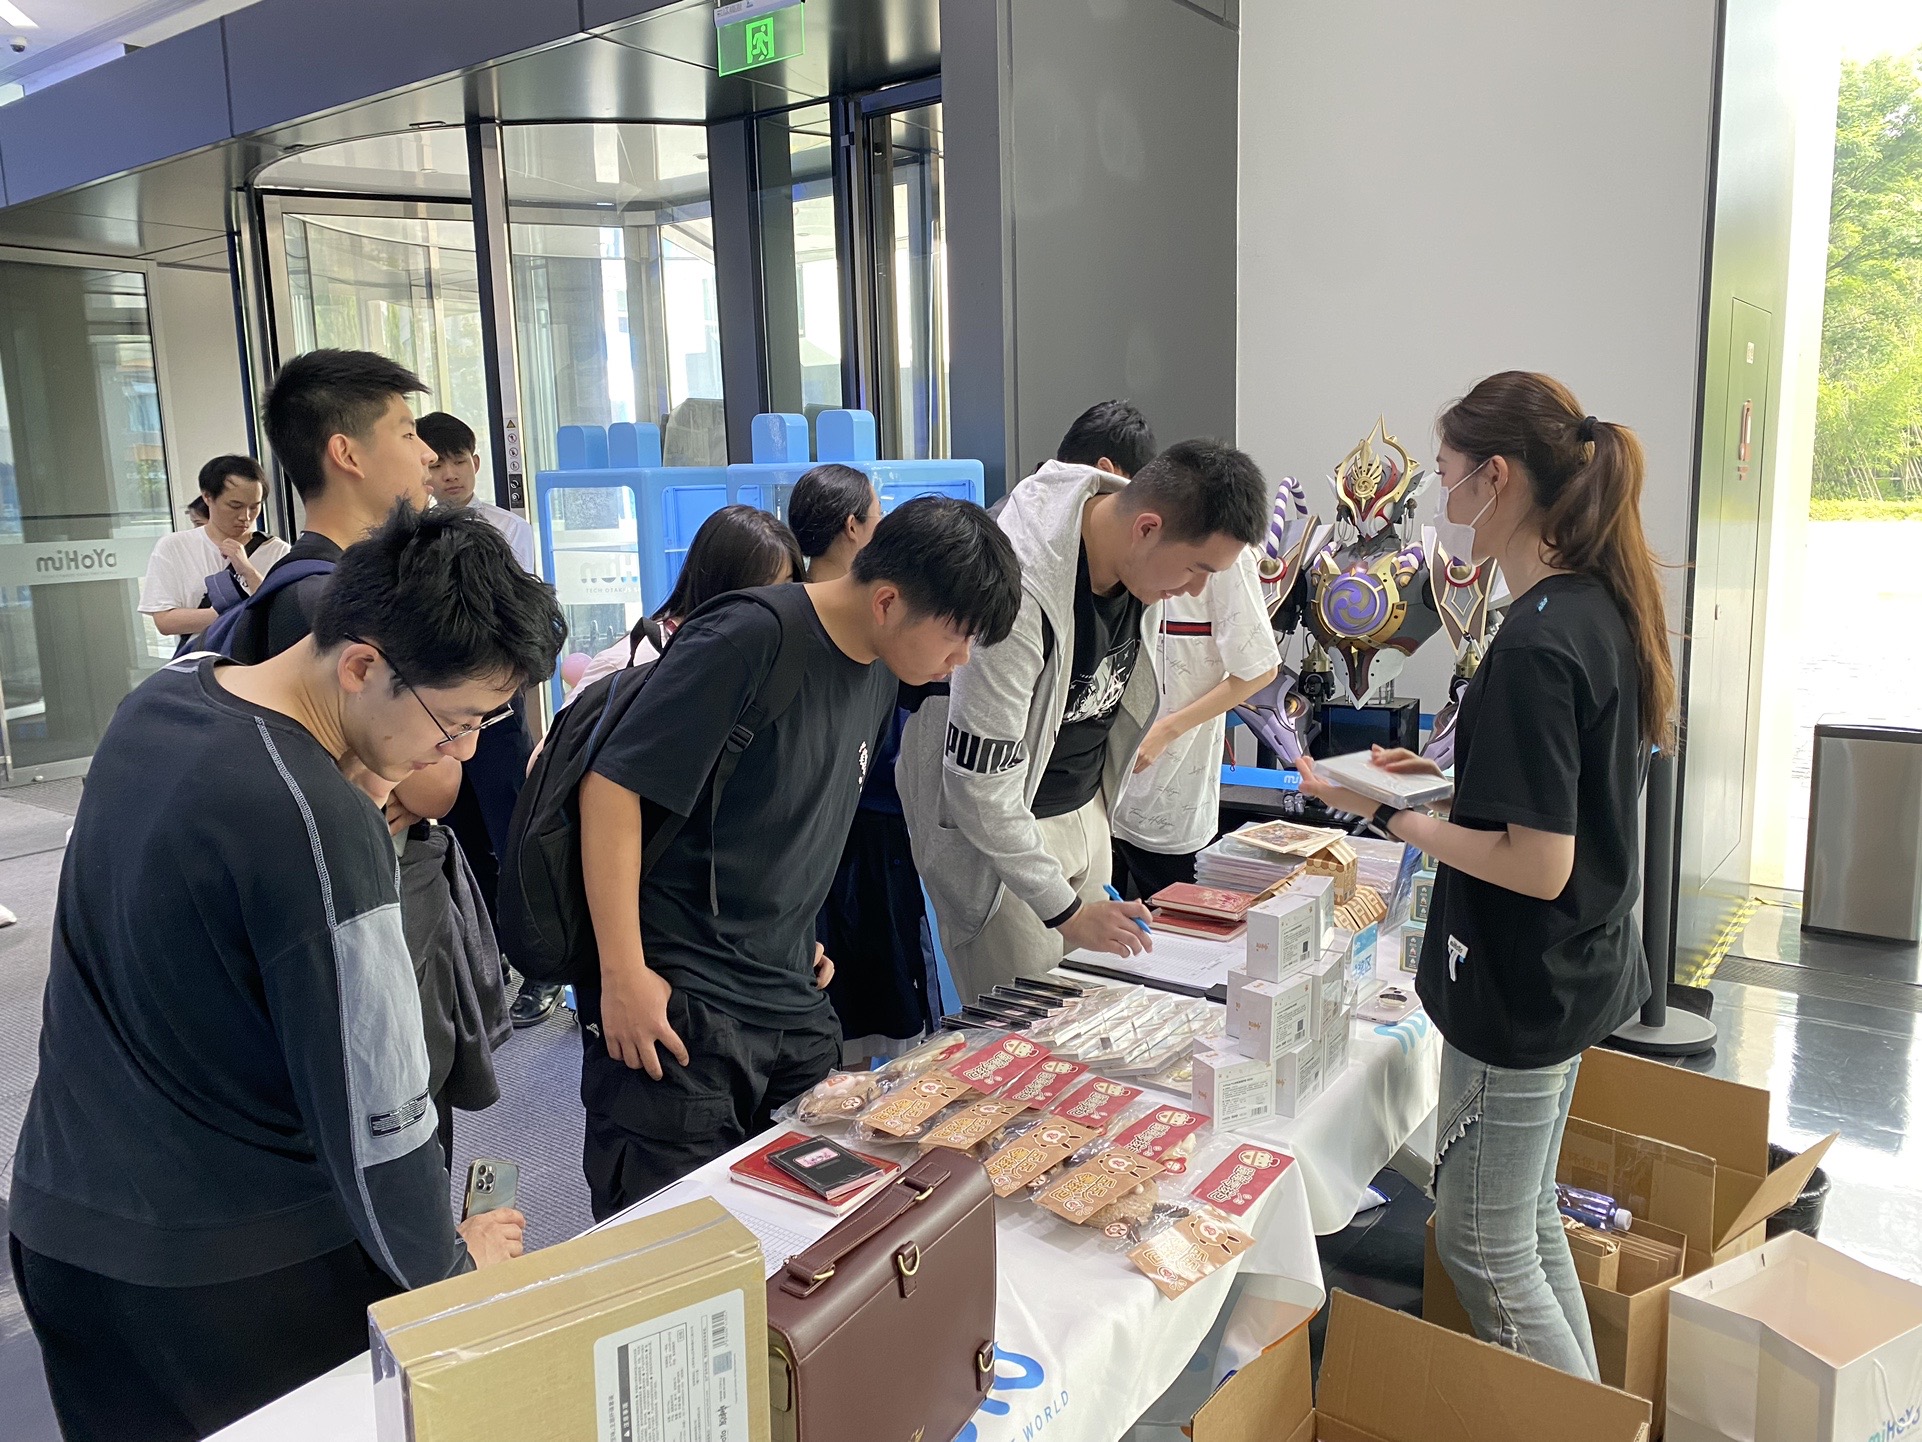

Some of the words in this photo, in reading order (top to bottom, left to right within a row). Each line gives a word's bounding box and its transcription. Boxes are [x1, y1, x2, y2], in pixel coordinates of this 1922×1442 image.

[36, 548, 118, 572] miHoYo
[580, 553, 639, 584] miH
[1283, 773, 1300, 784] mi
[1022, 1390, 1069, 1442] WORLD
